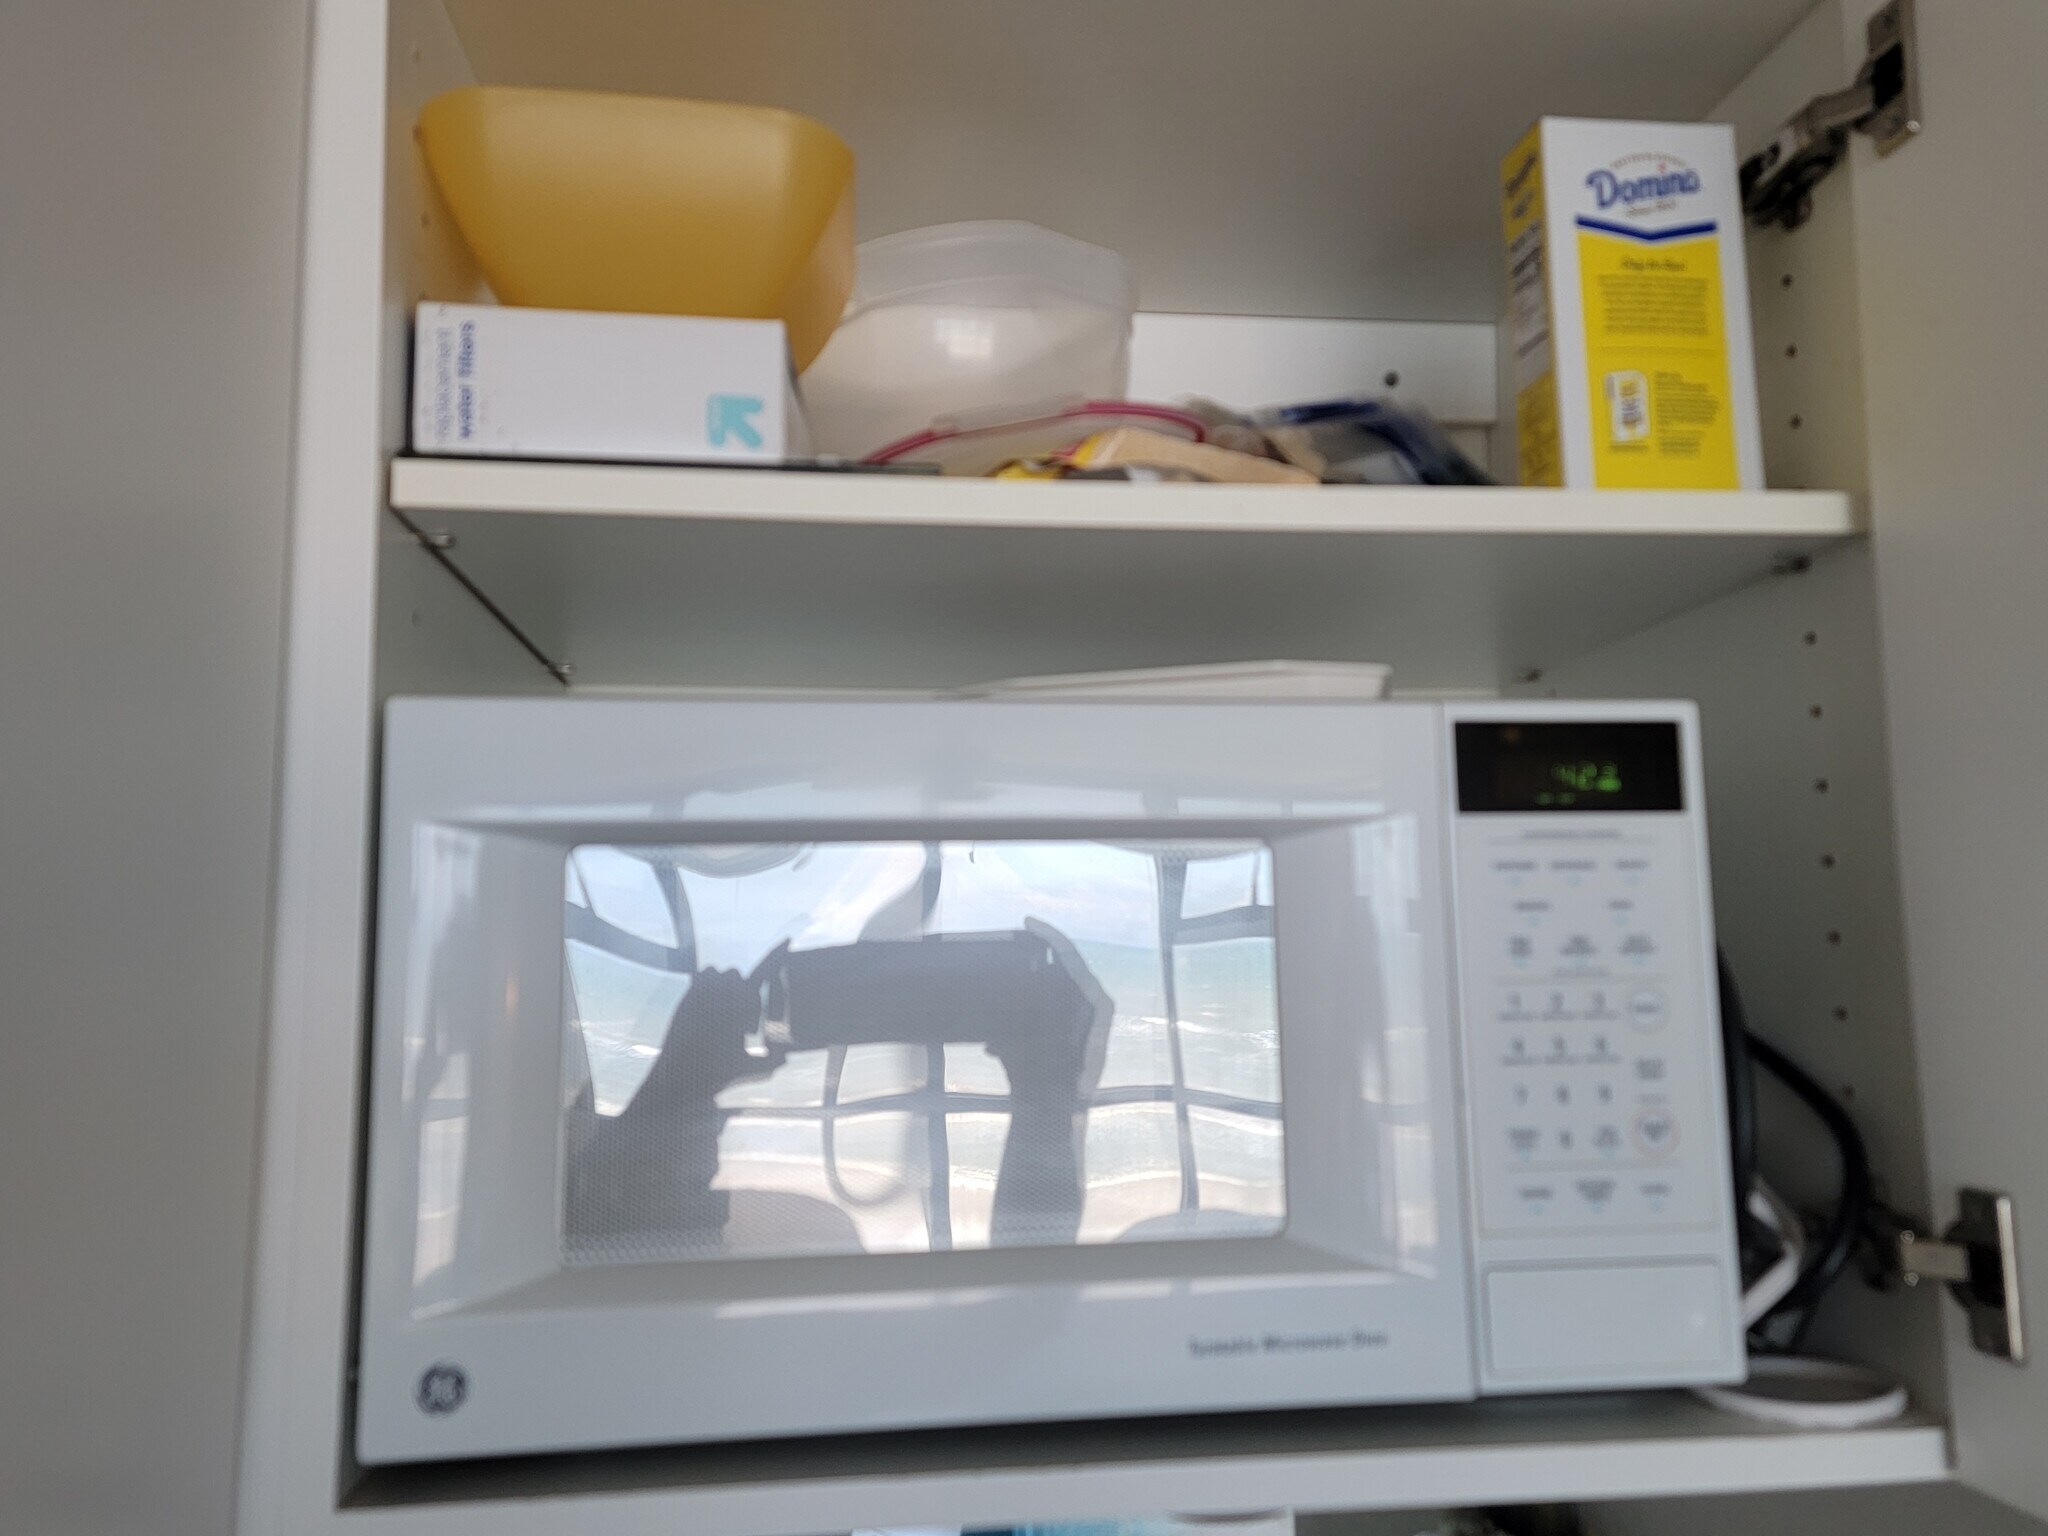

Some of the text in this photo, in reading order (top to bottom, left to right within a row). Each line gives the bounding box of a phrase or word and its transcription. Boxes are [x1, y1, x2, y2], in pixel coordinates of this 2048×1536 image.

[1585, 164, 1702, 209] Domino
[458, 320, 475, 438] water filters
